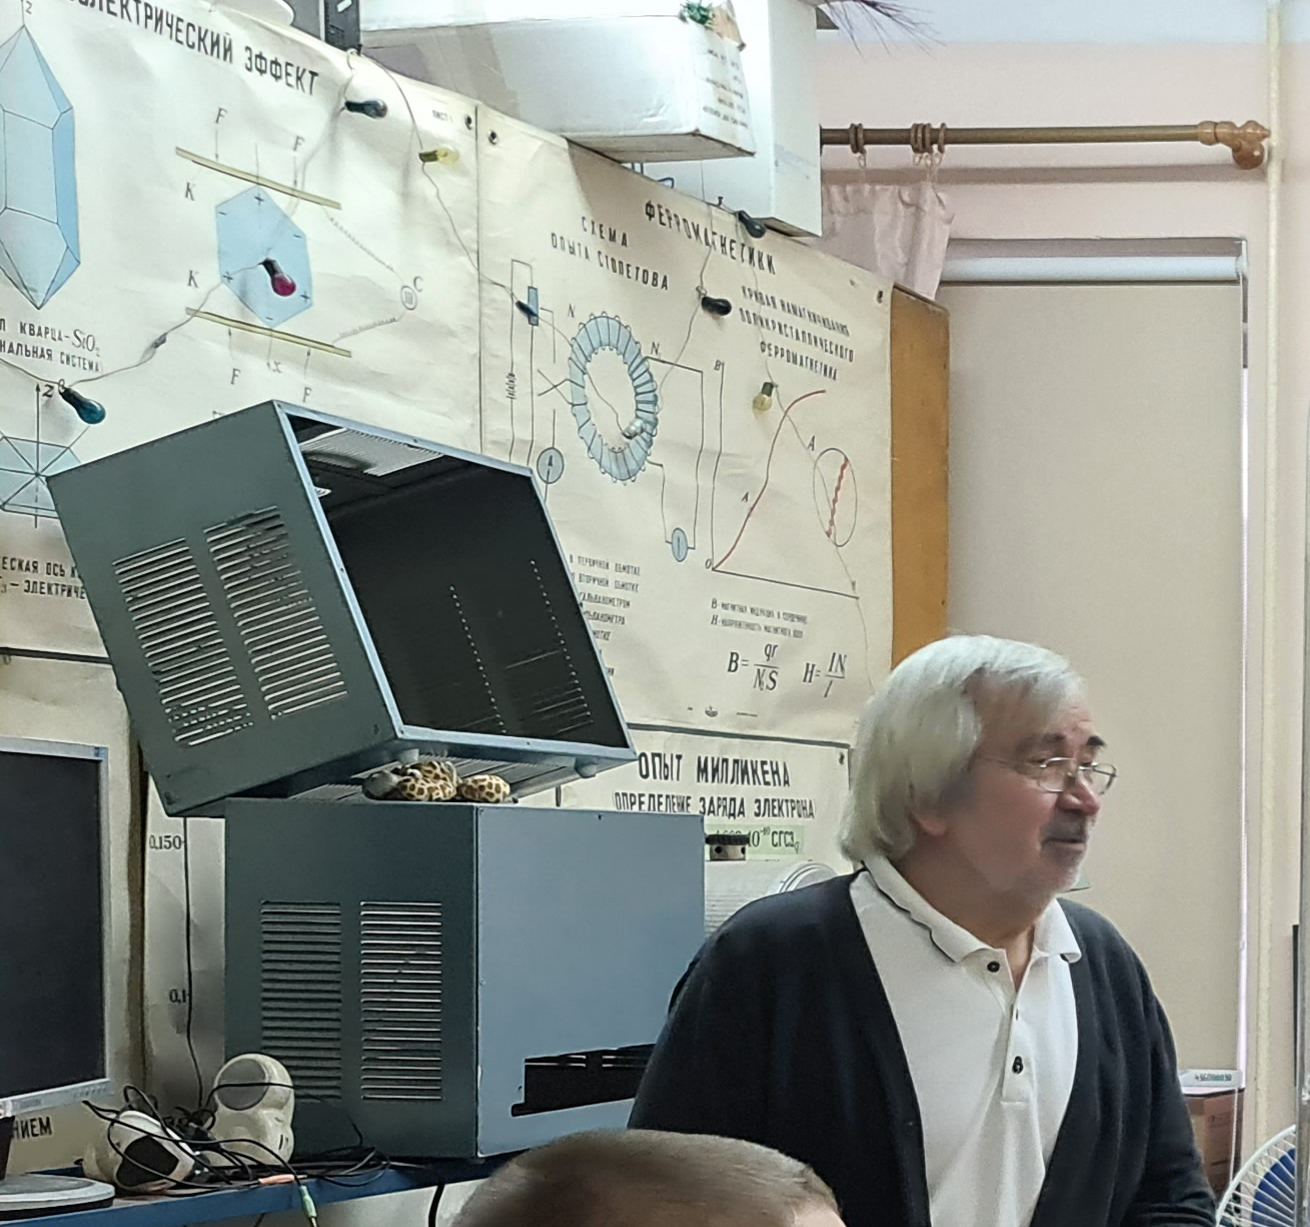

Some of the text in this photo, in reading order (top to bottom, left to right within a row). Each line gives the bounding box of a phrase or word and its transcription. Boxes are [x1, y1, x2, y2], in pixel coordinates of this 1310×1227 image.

[244, 45, 319, 96] ЭФФЕКТ
[581, 216, 629, 249] СХЕМА
[644, 200, 777, 276] ФЕРРОМАГНЕТИКИ
[550, 232, 669, 291] ОПЫТА СТОЛЕТОВА
[59, 351, 101, 373] СИСТЕМА
[45, 562, 66, 577] ОСЬ
[638, 752, 791, 787] ОПЫТ МИЛЛИКЕНА
[614, 792, 815, 820] ОПРЕДЕЛЕНИЕ ЗАРЯДА ЭЛЕКТРОНА
